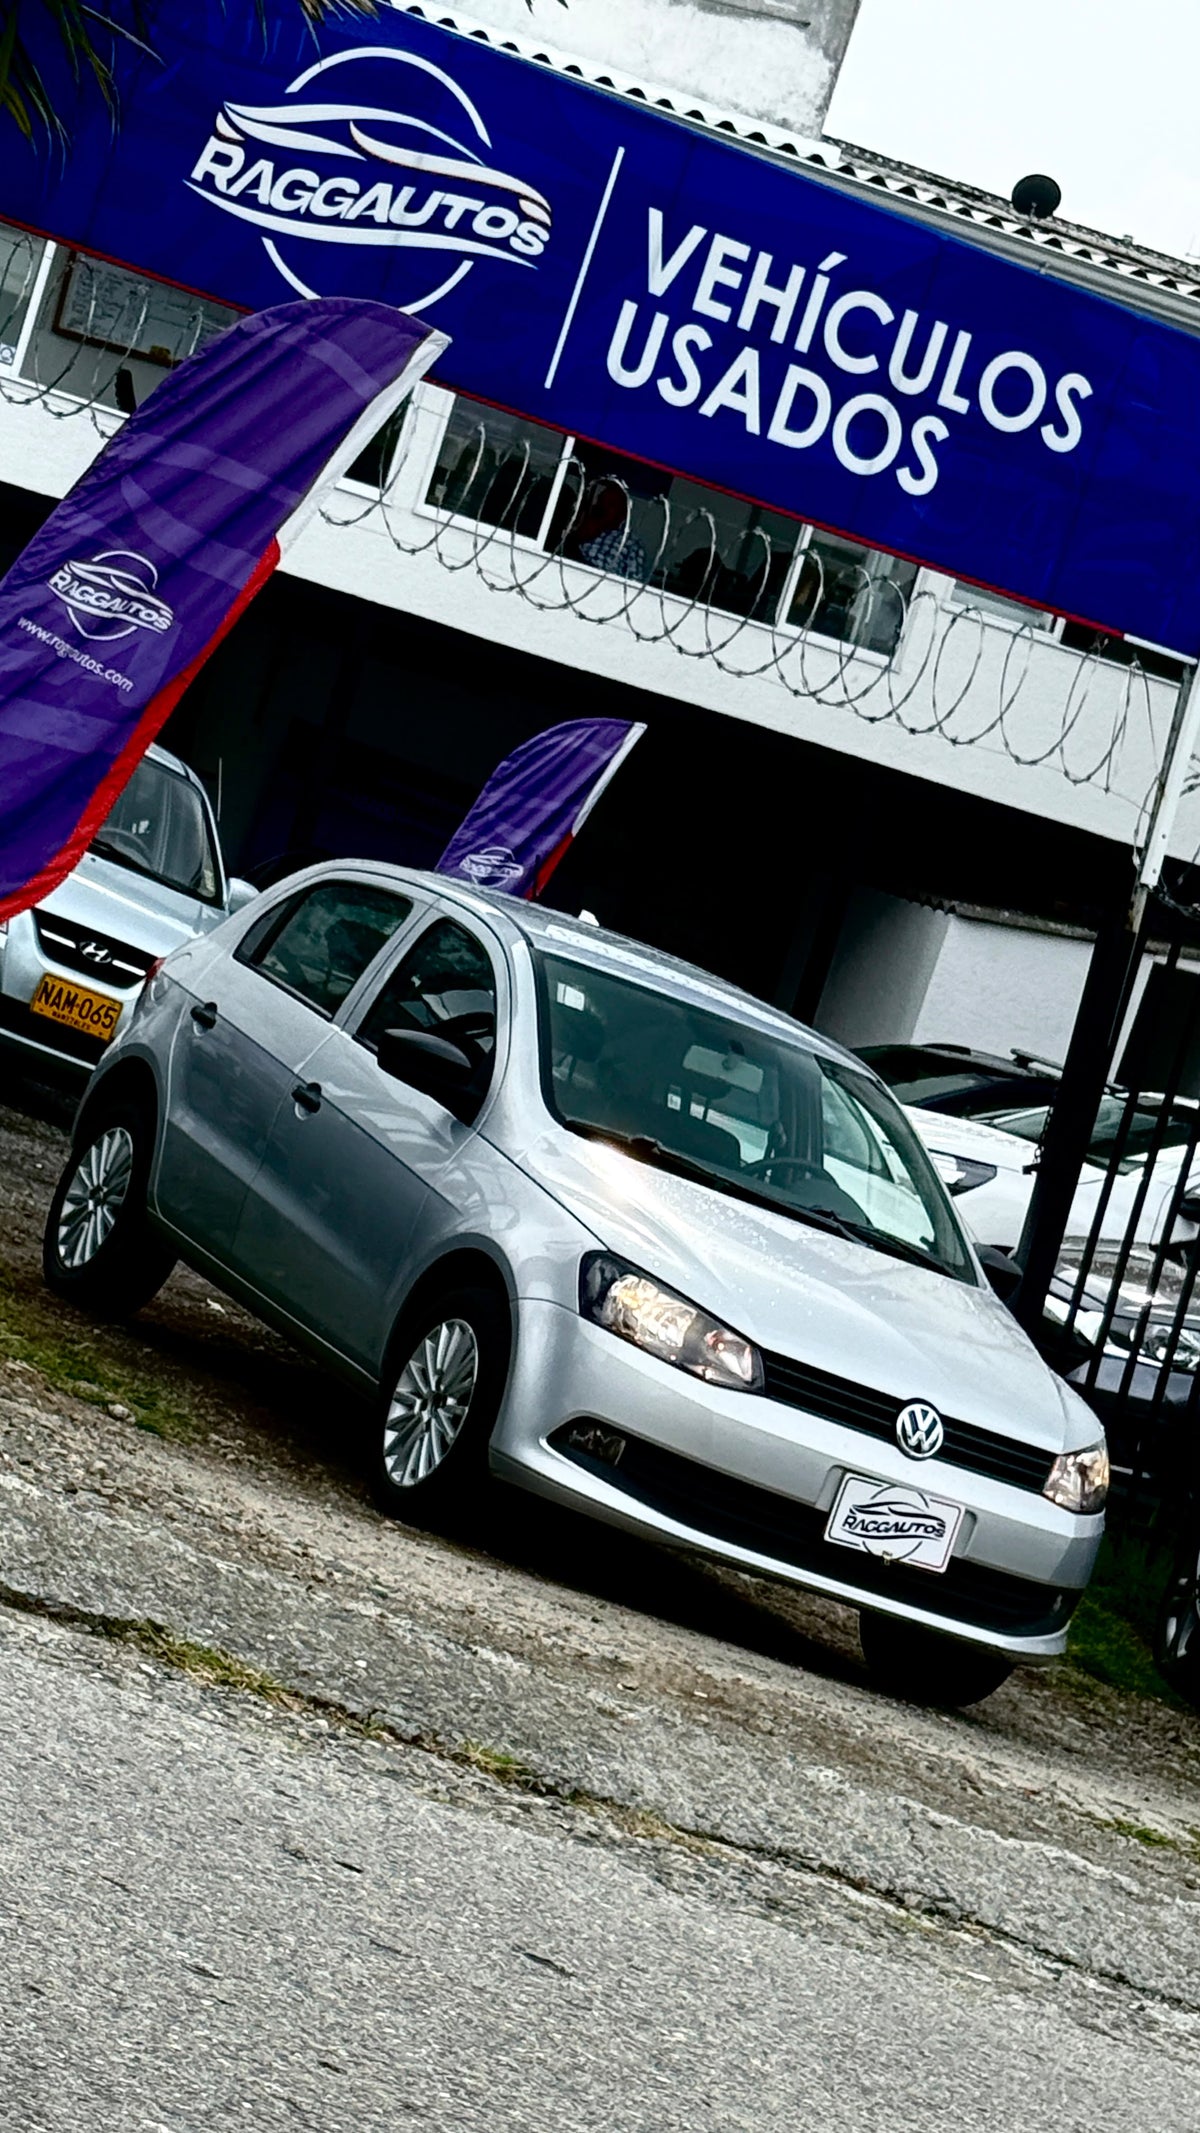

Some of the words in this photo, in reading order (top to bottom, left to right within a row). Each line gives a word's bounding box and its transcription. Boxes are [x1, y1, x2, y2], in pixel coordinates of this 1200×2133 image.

[191, 136, 550, 256] RAGGAUTOS
[648, 207, 1094, 453] VEHÍCULOS
[607, 300, 950, 496] USADOS
[50, 569, 172, 631] RAGGAUTOS
[842, 1515, 946, 1539] RAGGAUTOS
